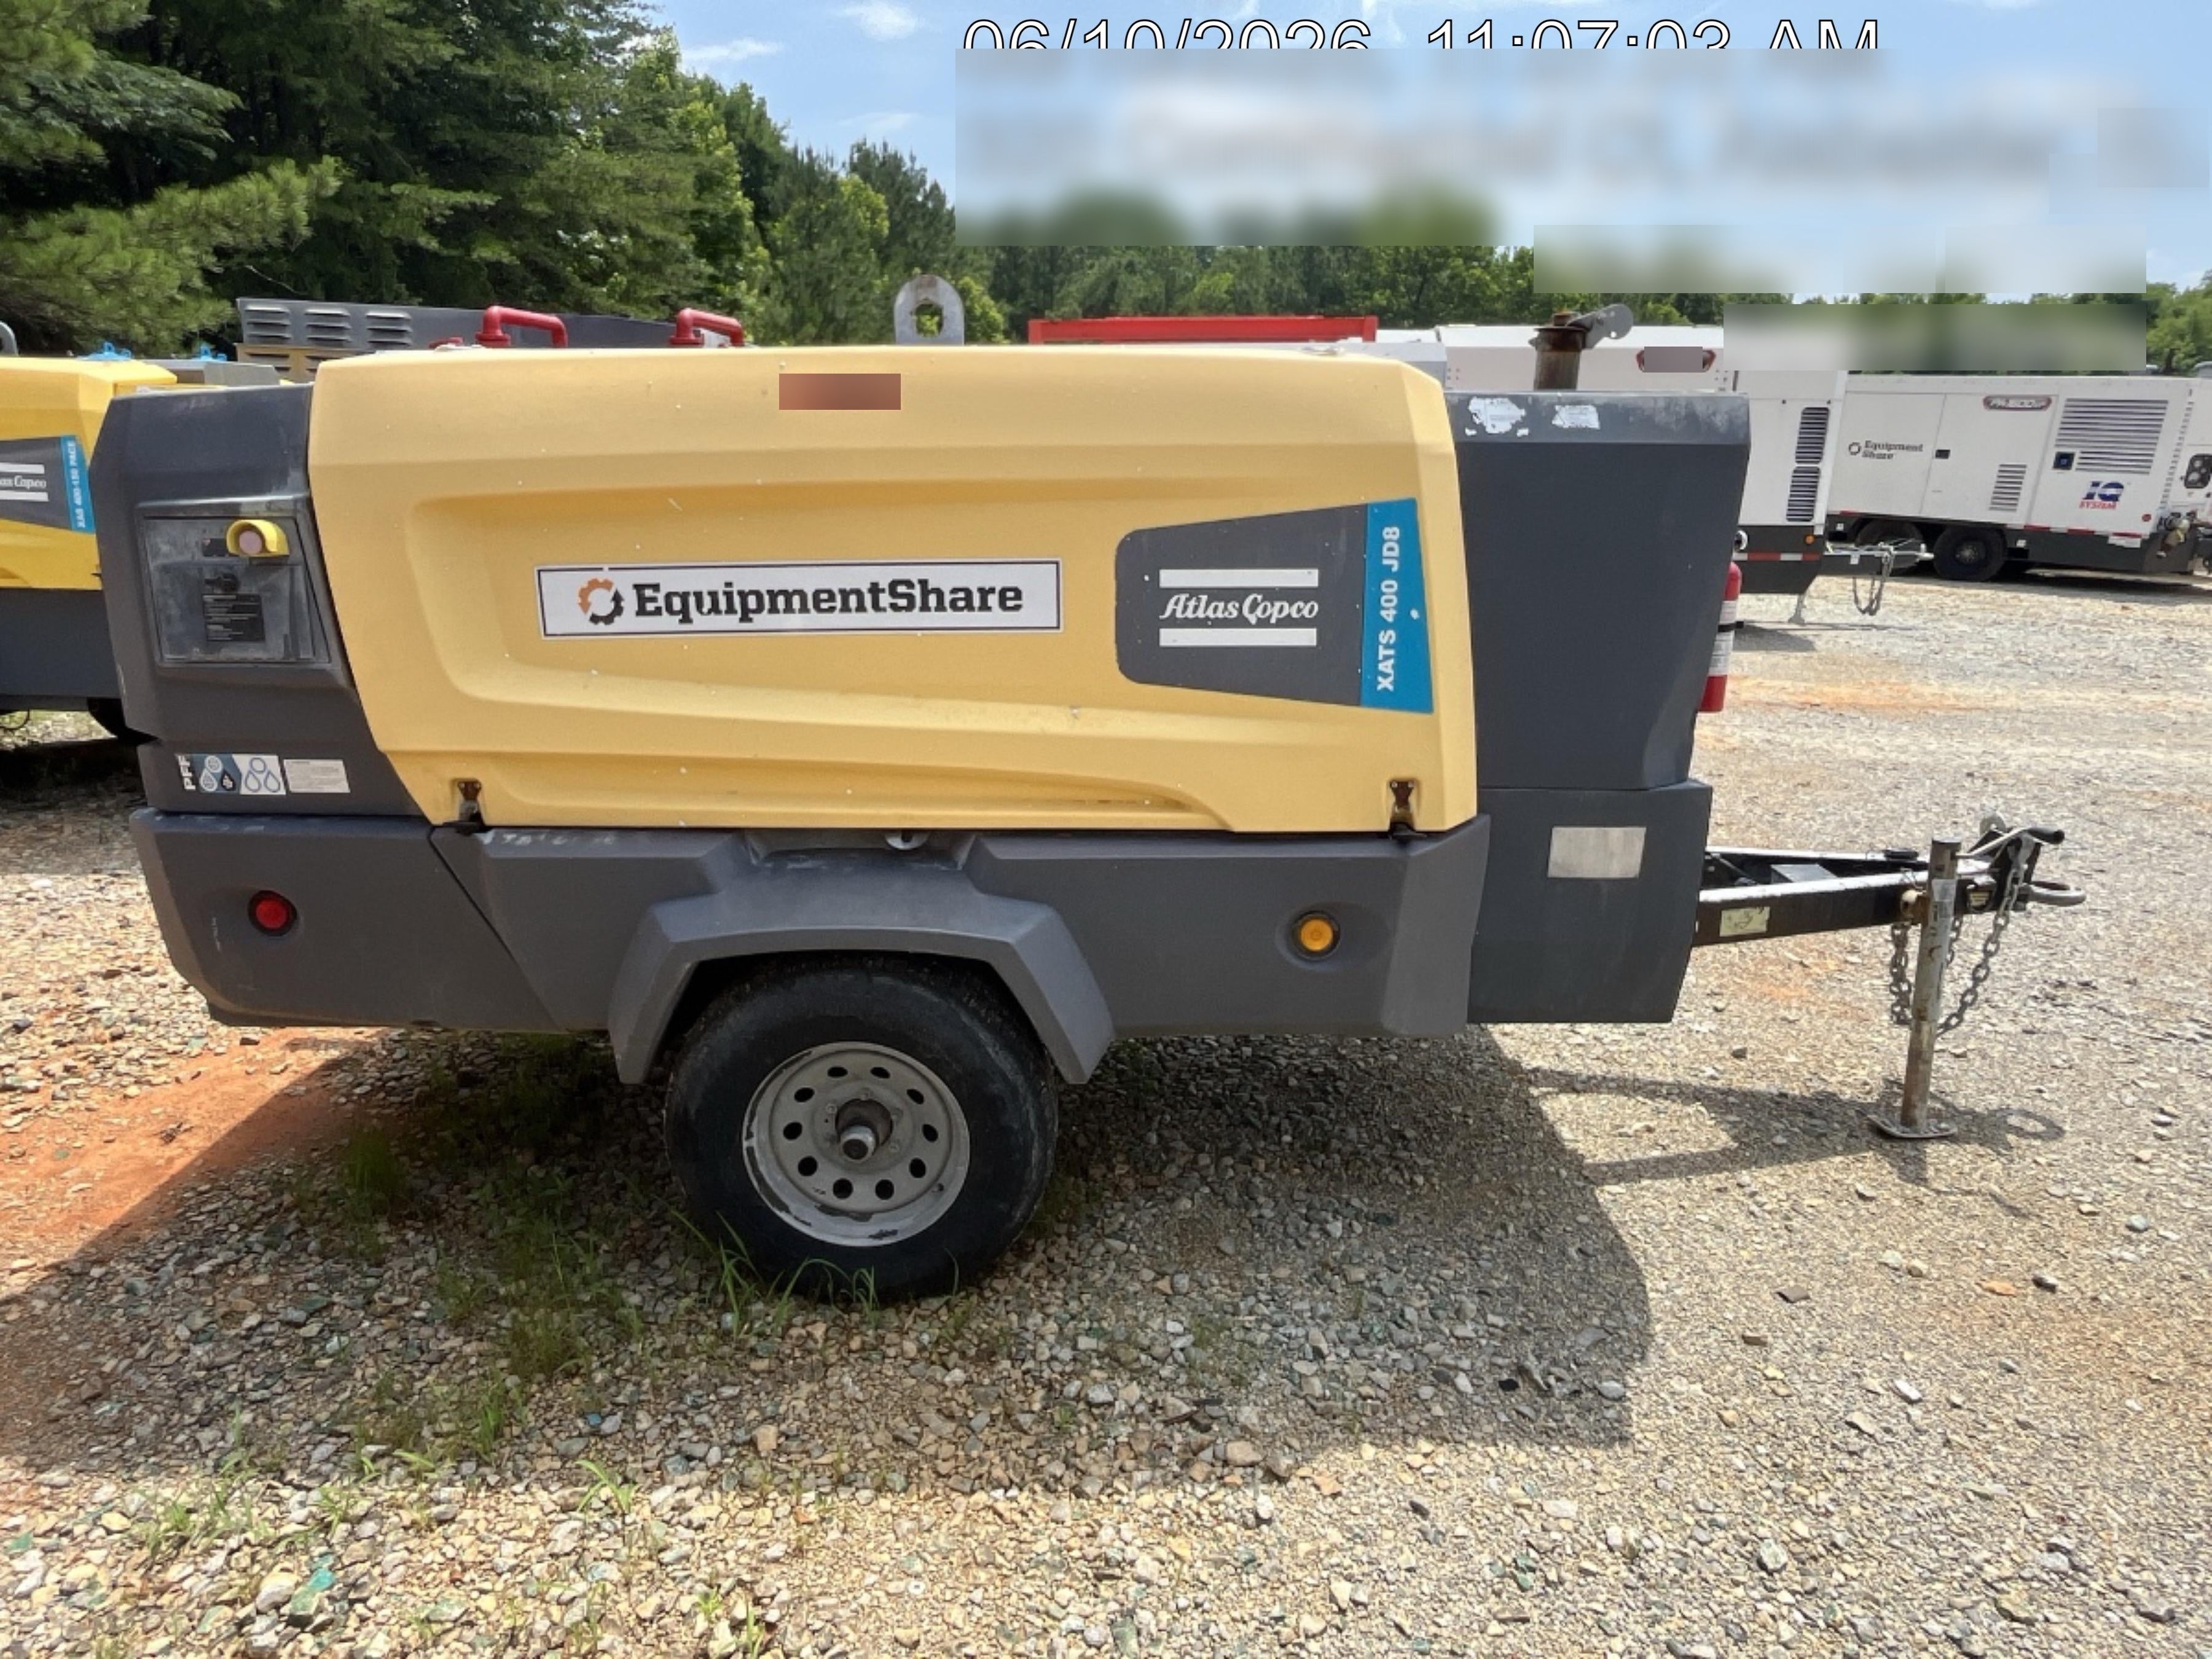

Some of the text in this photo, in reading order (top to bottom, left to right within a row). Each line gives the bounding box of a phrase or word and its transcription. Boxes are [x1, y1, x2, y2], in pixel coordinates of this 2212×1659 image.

[632, 578, 1023, 624] EquipmentShare
[1159, 593, 1319, 626] Atlas Copco
[1377, 527, 1400, 692] XATS 400 JD8
